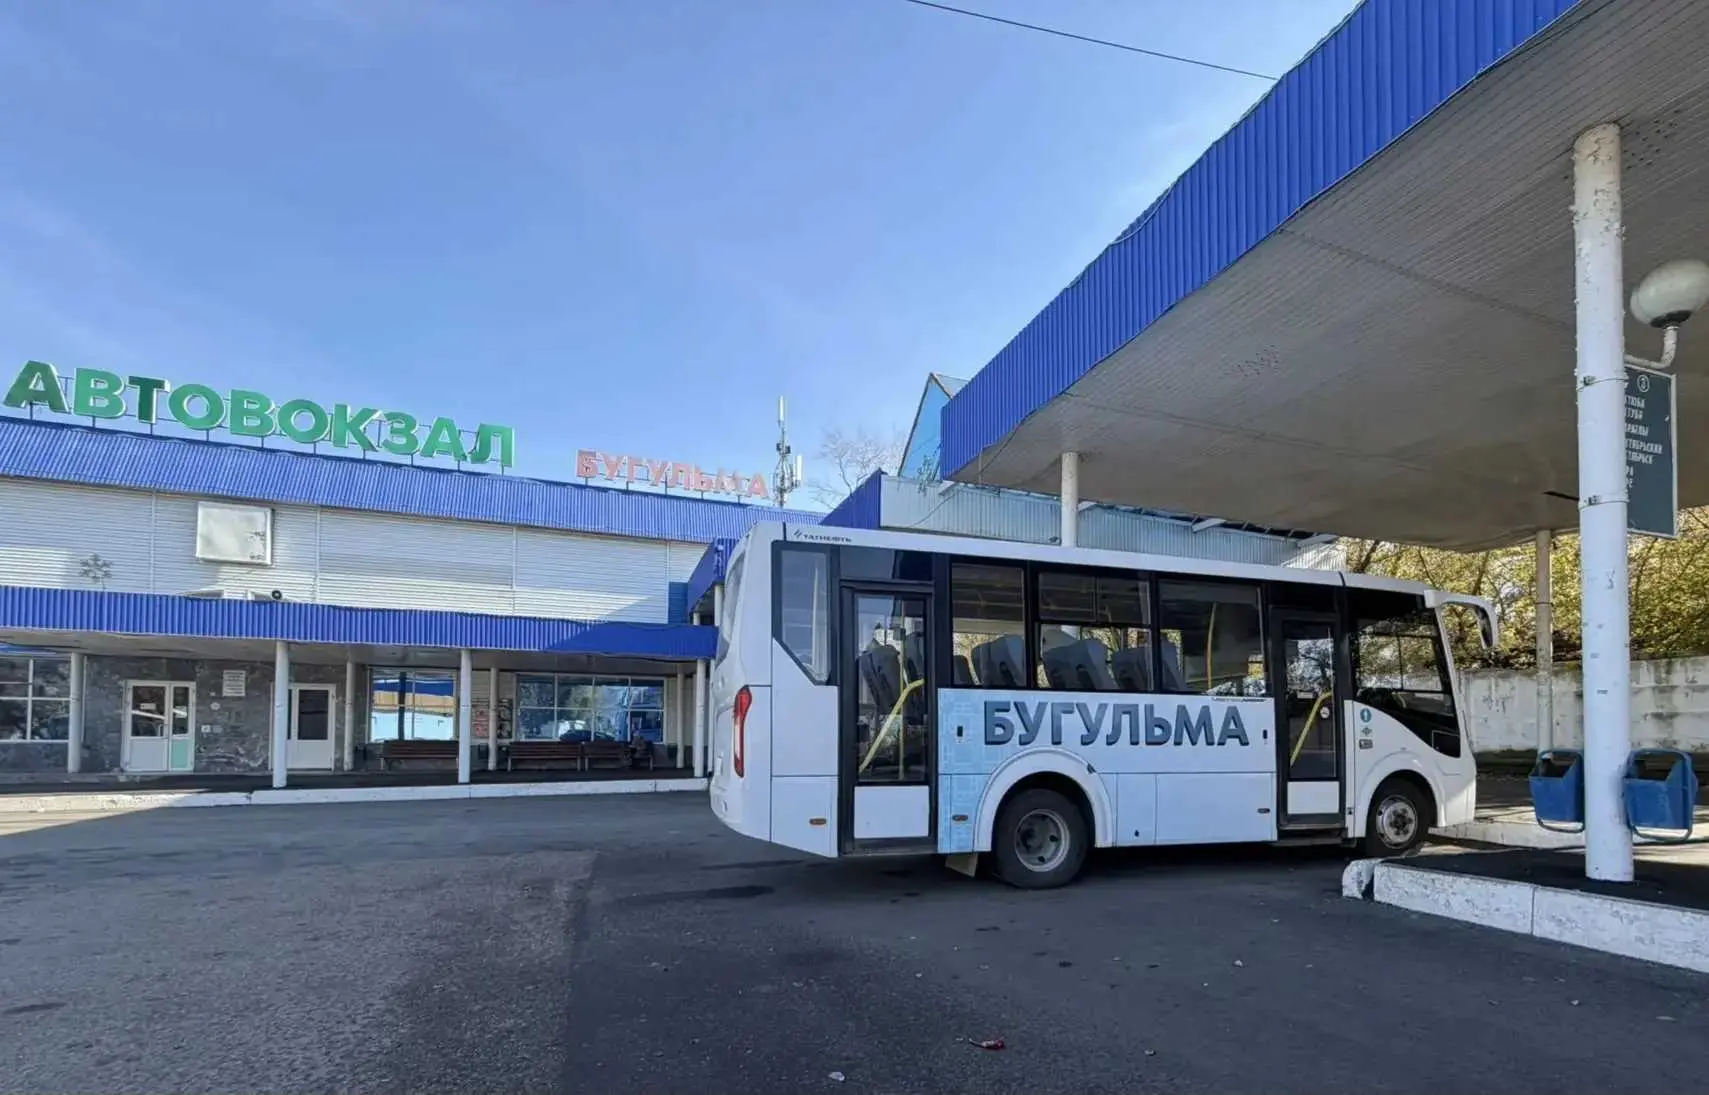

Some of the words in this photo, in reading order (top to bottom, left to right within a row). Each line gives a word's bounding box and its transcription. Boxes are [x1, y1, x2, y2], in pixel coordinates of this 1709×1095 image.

[3, 359, 516, 467] АВТОВОКЗАЛ
[576, 449, 770, 499] БУГУЛЬМА
[983, 699, 1249, 747] БУГУЛЬМА
